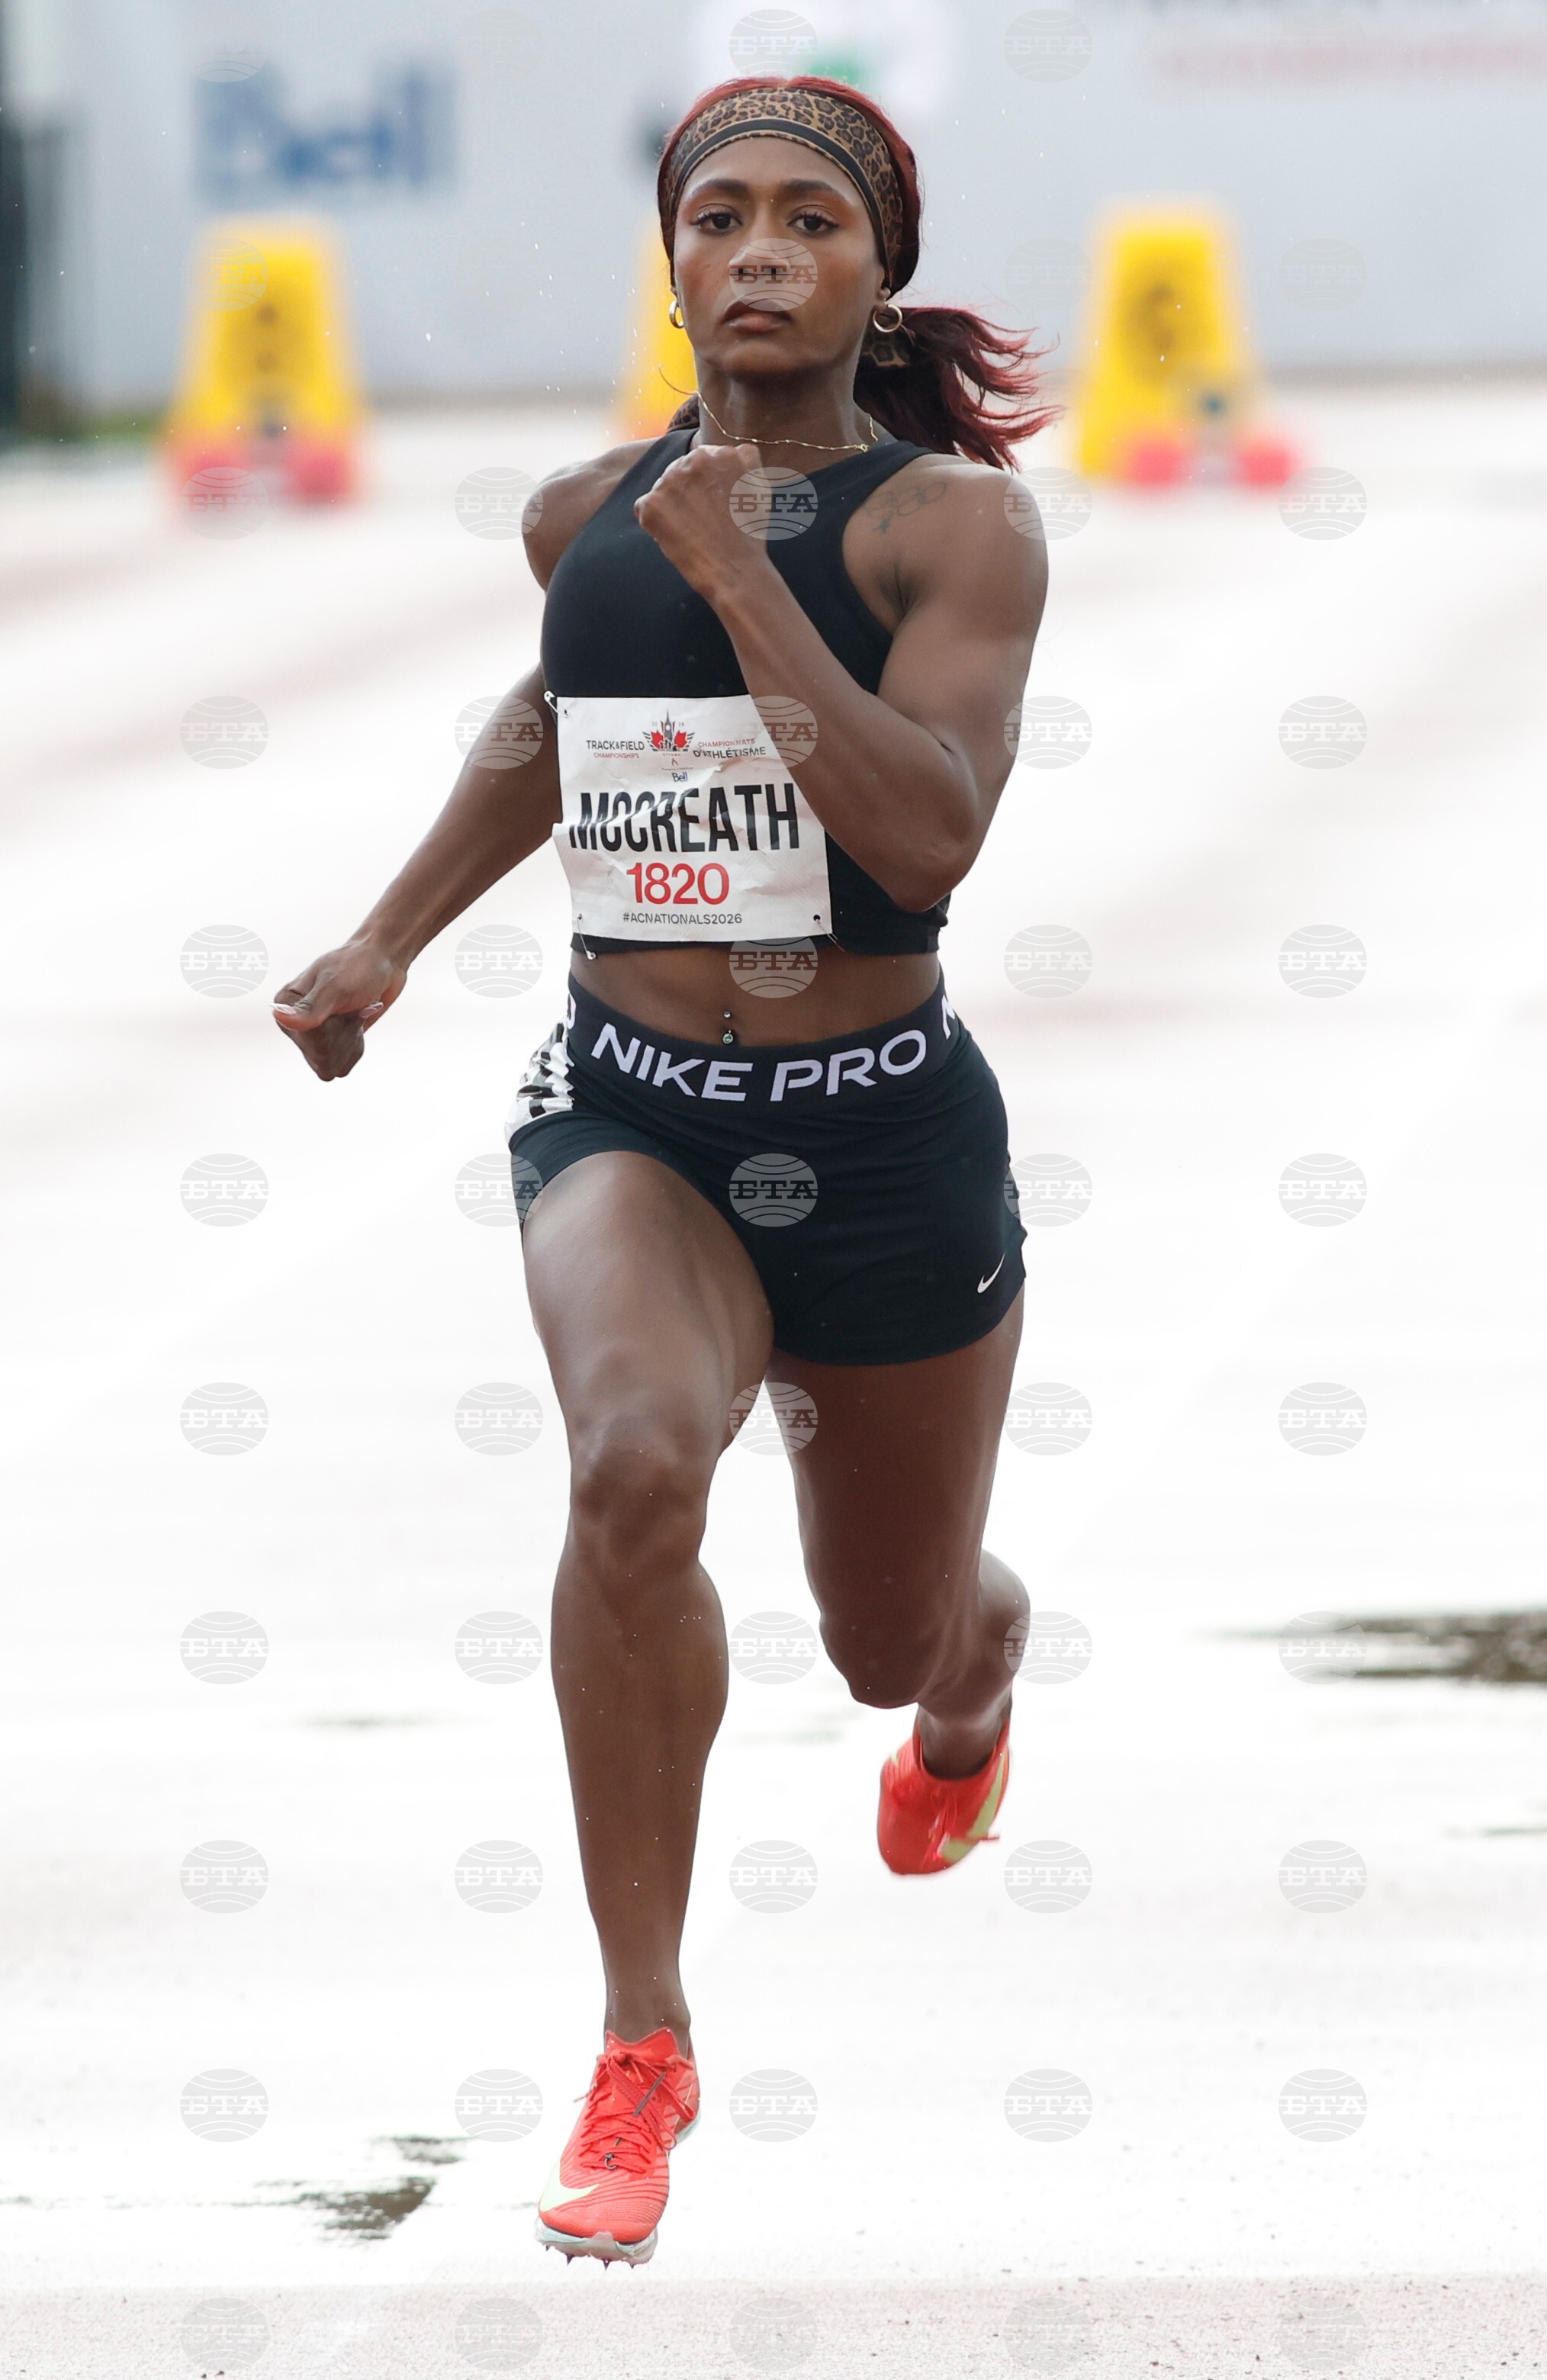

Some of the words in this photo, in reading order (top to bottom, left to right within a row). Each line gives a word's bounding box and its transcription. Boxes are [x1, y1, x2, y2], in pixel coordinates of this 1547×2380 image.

[586, 740, 645, 751] TRACK&FIELD
[697, 738, 756, 748] CHAMPIONNATS
[693, 746, 766, 759] D'ATHLÉTISME
[672, 772, 688, 783] Bell
[569, 783, 799, 852] MCCREATH
[626, 863, 730, 905] 1820
[622, 912, 743, 925] #ACNATIONALS2026
[591, 1023, 754, 1102] NIKE
[770, 1030, 927, 1102] PRO
